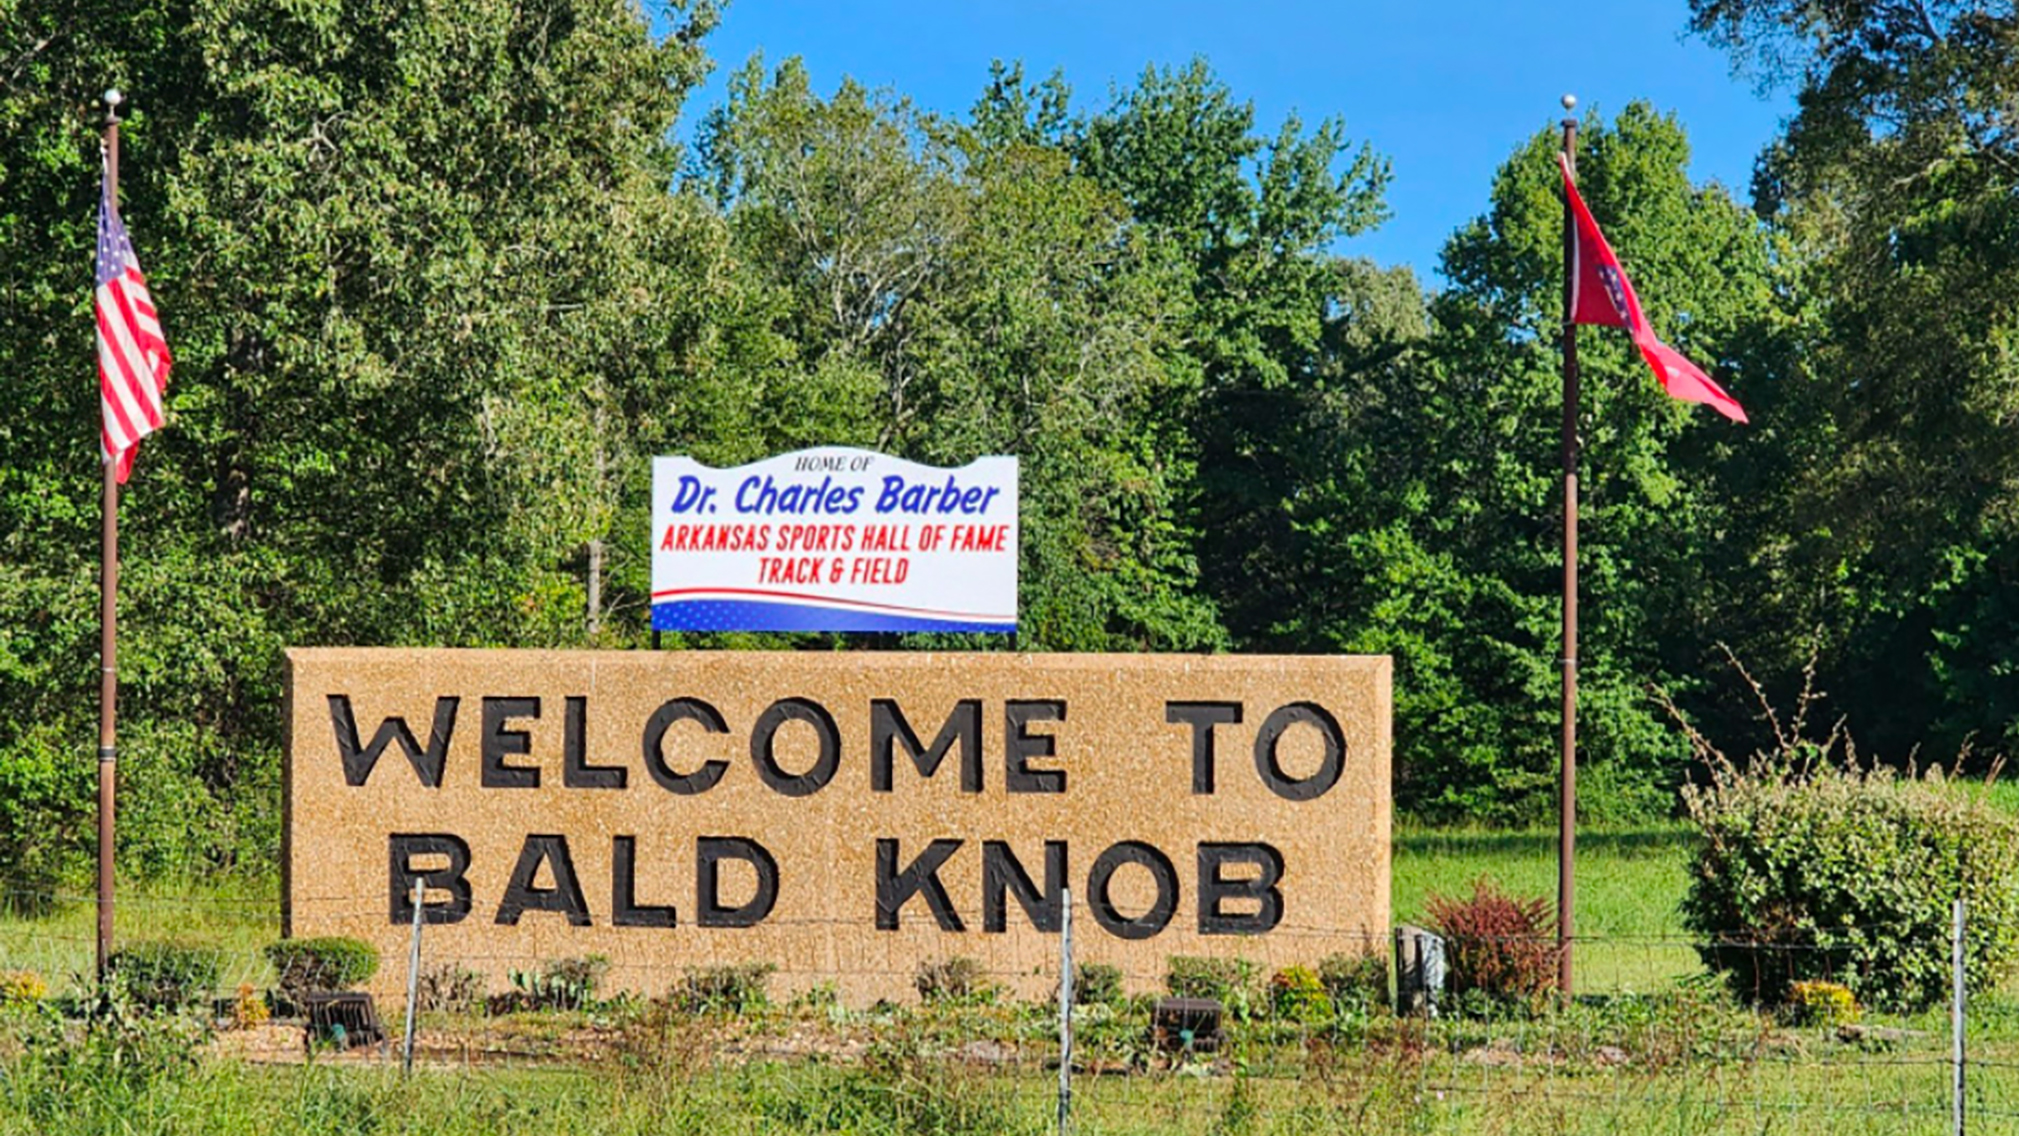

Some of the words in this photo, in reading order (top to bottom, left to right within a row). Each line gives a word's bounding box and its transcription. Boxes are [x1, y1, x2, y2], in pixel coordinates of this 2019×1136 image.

[794, 456, 846, 472] HOME
[850, 456, 875, 472] OF
[671, 475, 717, 514] Dr.
[734, 474, 865, 514] Charles
[875, 475, 1000, 514] Barber
[660, 524, 771, 551] ARKANSAS
[776, 524, 856, 551] SPORTS
[860, 524, 911, 551] HALL
[918, 524, 946, 551] OF
[950, 524, 1010, 552] FAME
[758, 557, 826, 584] TRACK
[829, 557, 844, 584] &
[850, 557, 910, 584] FIELD
[326, 693, 1068, 797] WELCOME
[1165, 700, 1347, 802] TO
[388, 832, 781, 929] BALD
[874, 837, 1286, 941] KNOB
